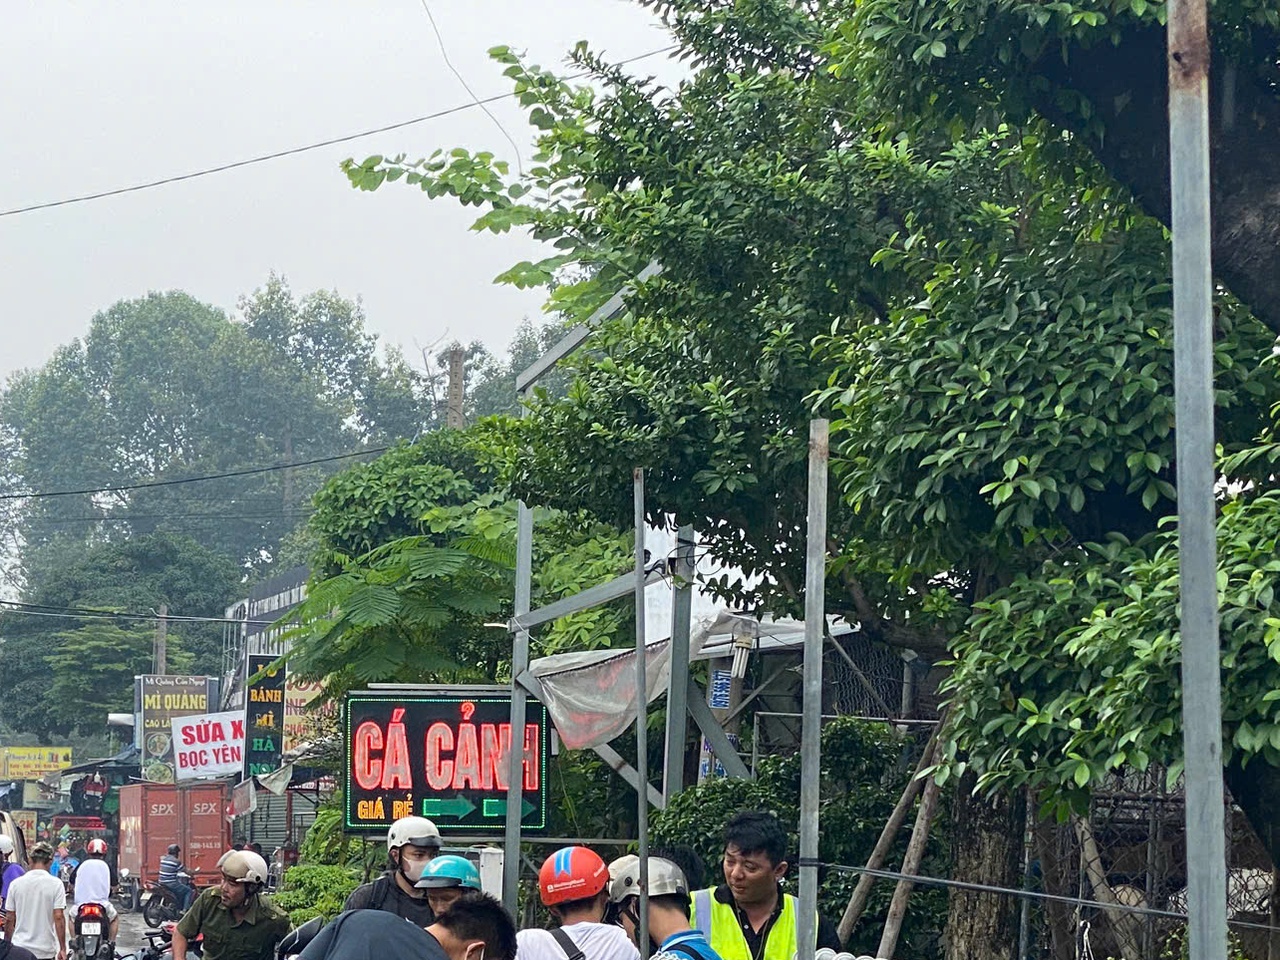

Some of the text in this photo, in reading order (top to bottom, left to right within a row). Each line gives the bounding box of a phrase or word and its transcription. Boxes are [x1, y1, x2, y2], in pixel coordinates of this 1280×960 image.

[145, 690, 207, 711] MÌ QUẢNG
[250, 686, 282, 703] BÁNH
[181, 719, 225, 746] SỬA
[252, 736, 275, 751] HÀ
[354, 700, 539, 791] CÁ CẢNH
[178, 746, 241, 771] BỌC YÊN
[151, 804, 174, 813] SPX
[193, 803, 217, 813] SPX
[357, 793, 414, 820] GIÁ RẺ
